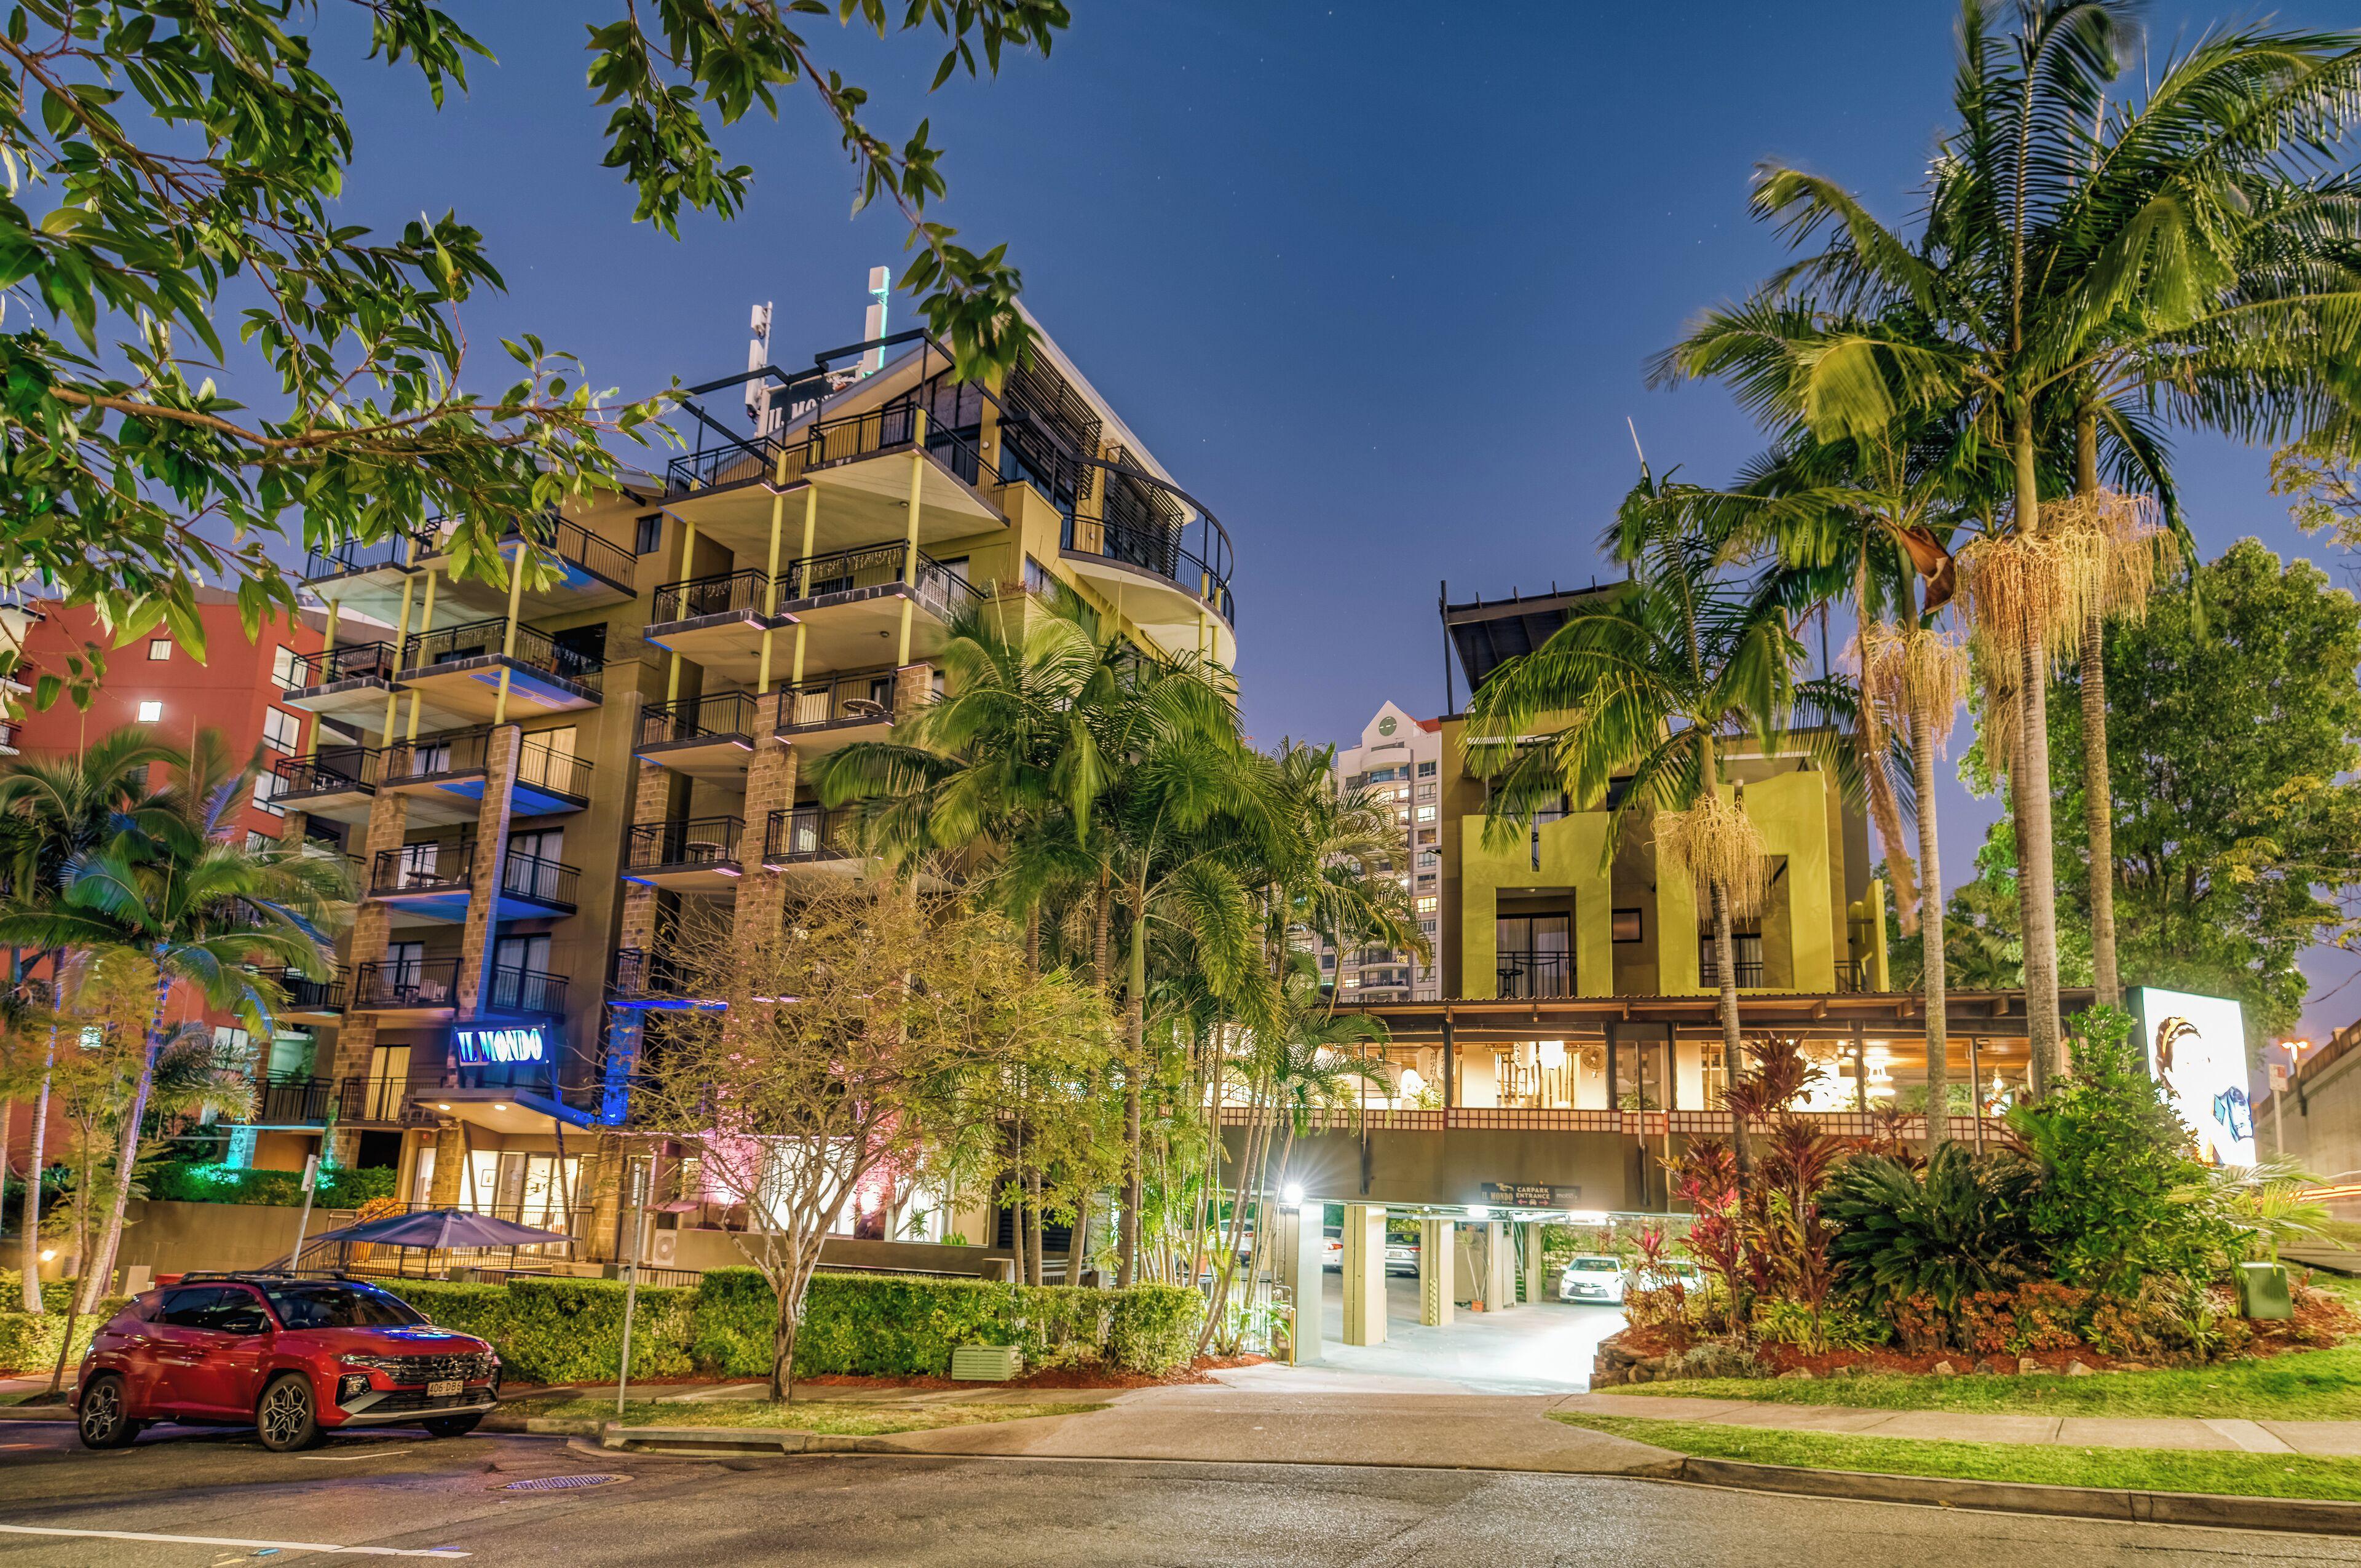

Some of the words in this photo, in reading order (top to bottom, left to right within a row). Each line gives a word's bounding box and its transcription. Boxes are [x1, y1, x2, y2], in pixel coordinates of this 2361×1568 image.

[457, 1031, 478, 1062] IL
[478, 1028, 543, 1063] MONDO
[1490, 1191, 1513, 1201] MONDO
